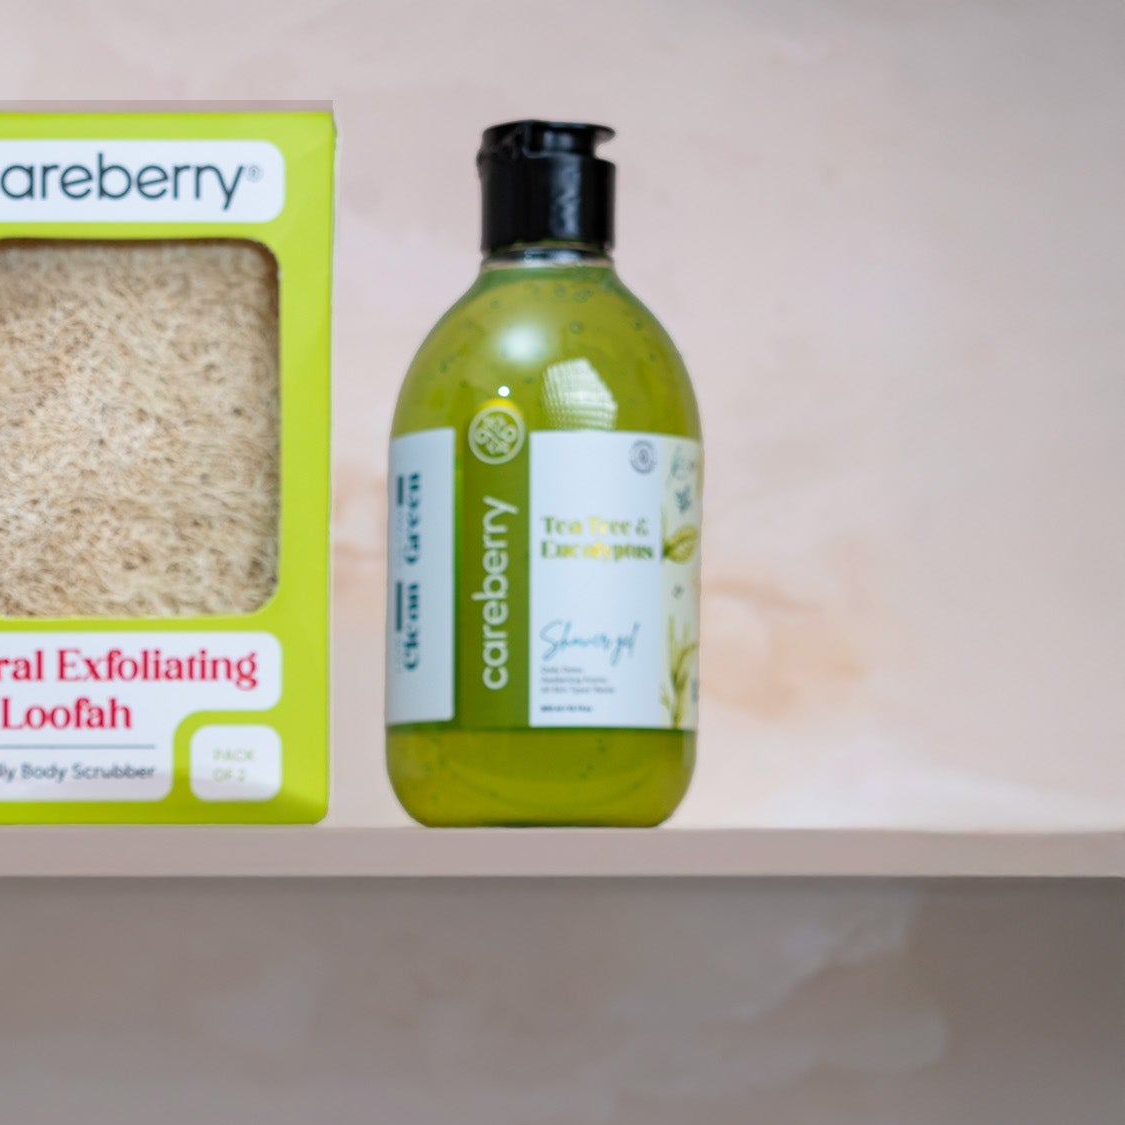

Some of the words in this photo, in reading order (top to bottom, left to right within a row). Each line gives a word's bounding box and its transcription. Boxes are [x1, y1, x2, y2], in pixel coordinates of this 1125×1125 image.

[404, 473, 422, 566] Green
[542, 516, 581, 535] Tea
[472, 496, 518, 690] careberry
[402, 582, 420, 672] Clean
[57, 648, 259, 690] Exfoliating
[1, 697, 133, 730] Loofah
[211, 748, 256, 762] PACK
[21, 763, 66, 783] Body
[72, 763, 155, 780] Scrubber
[212, 767, 233, 783] OF
